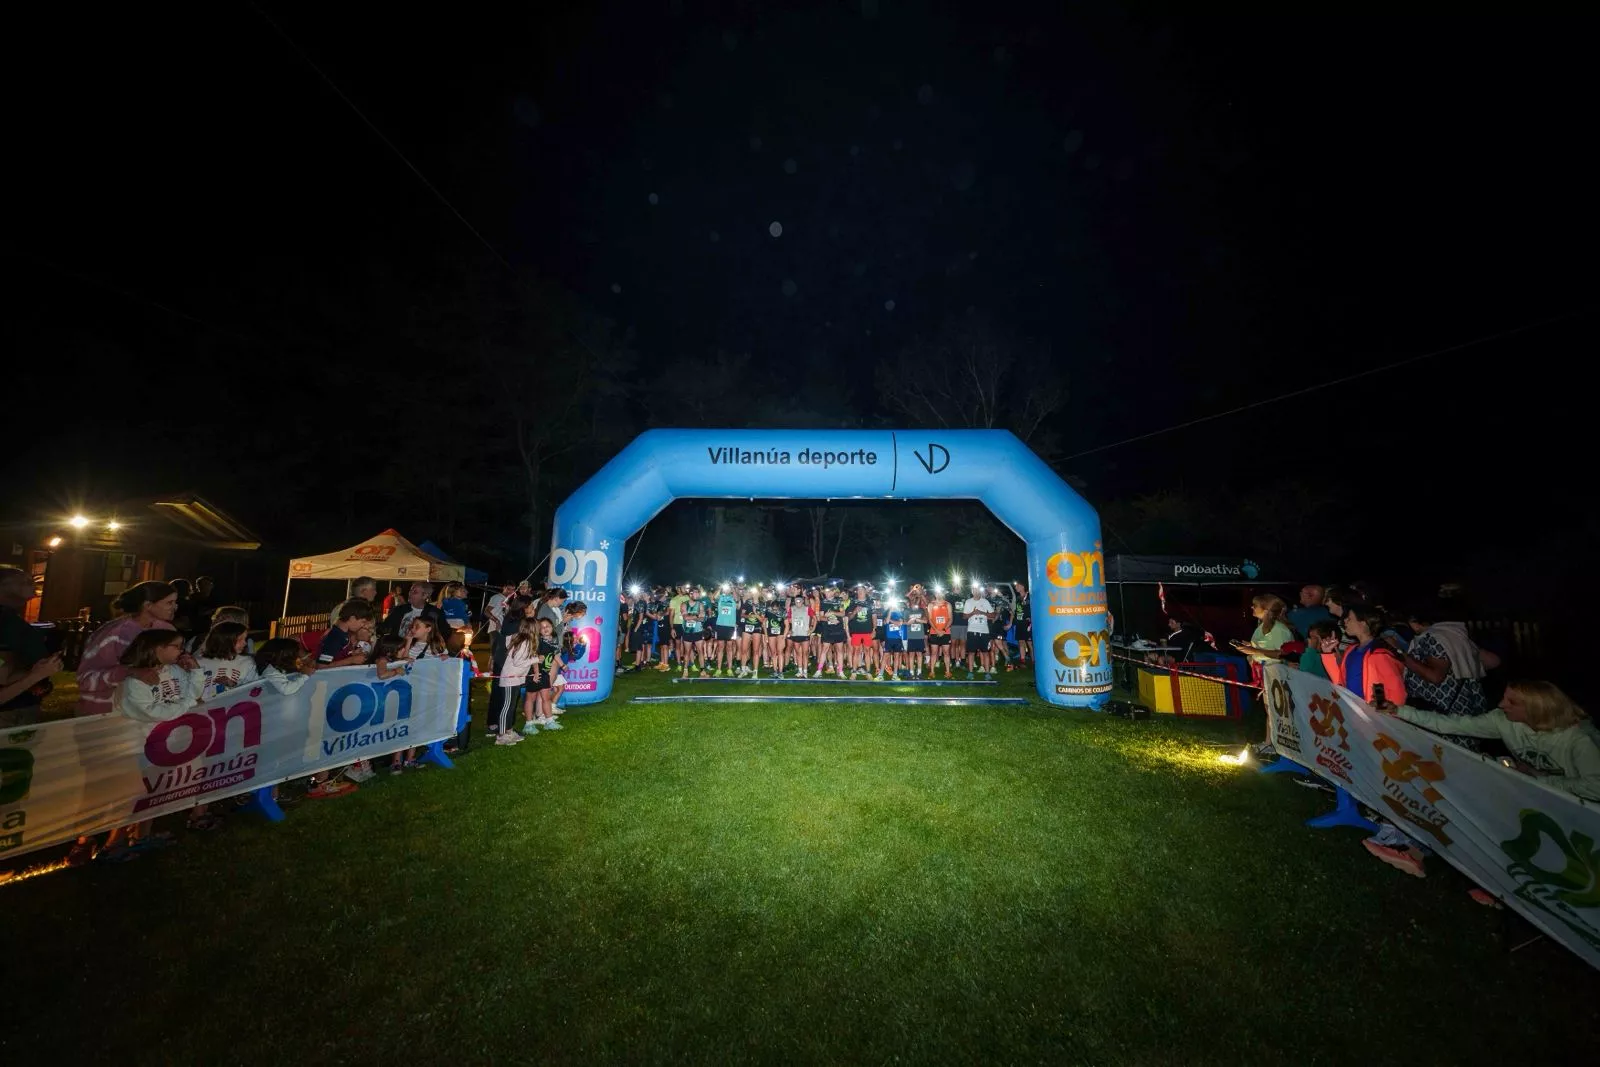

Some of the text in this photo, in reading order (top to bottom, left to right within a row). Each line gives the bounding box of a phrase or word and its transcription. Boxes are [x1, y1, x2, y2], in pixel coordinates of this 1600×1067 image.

[708, 446, 877, 469] Villanúa deporte
[1174, 563, 1241, 577] podoactiva
[1058, 686, 1084, 694] CAMINOS
[326, 679, 413, 733] on
[144, 701, 262, 768] on
[323, 724, 409, 756] Villanúa
[142, 752, 259, 794] Villanúa
[202, 774, 245, 792] OUTDOOR
